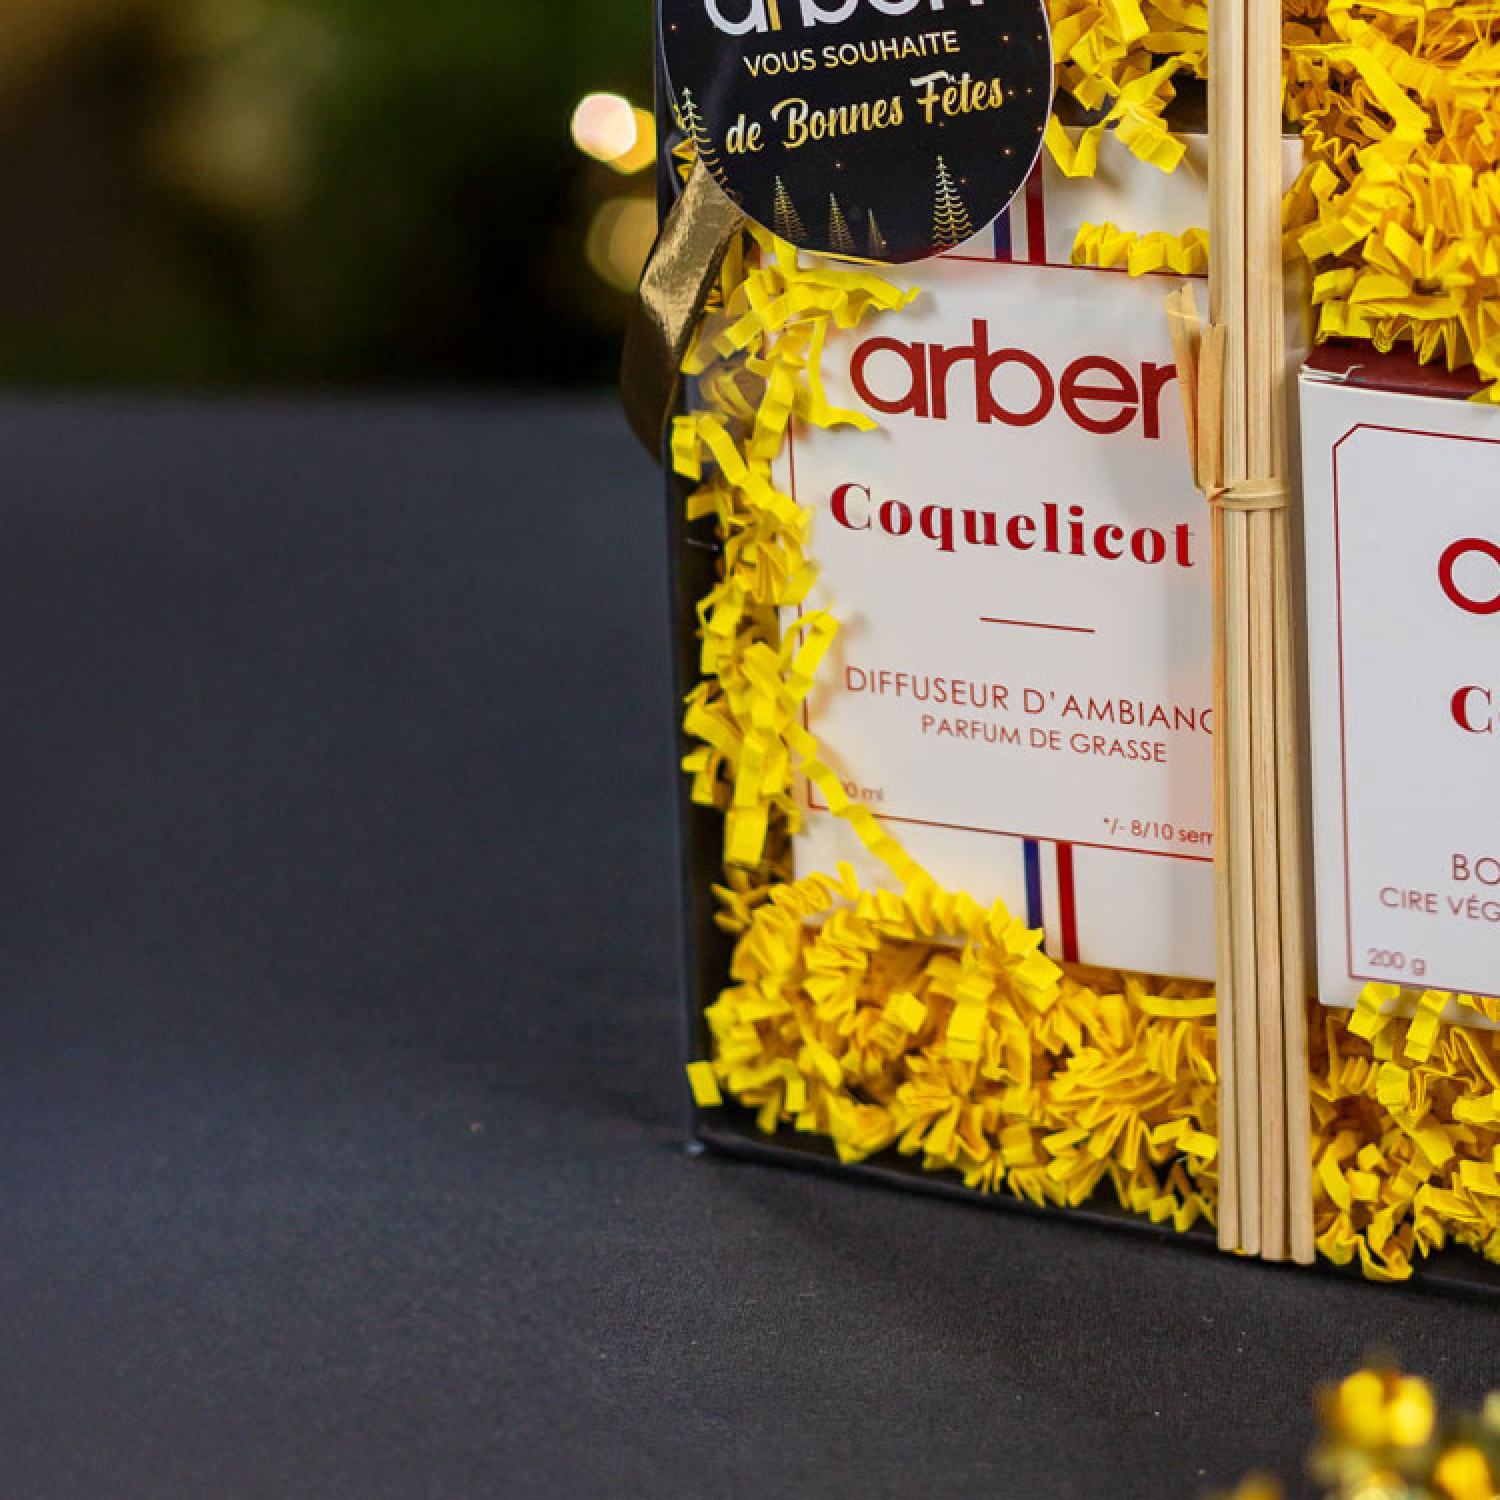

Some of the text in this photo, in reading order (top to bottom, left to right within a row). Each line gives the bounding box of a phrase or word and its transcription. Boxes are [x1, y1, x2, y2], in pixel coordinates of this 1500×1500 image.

[742, 29, 961, 78] VOUS SOUHAITE
[725, 69, 1004, 155] de Bonnes Fêtes
[849, 317, 1177, 439] arber
[829, 482, 1196, 567] Coquelicot
[845, 665, 1213, 735] DIFFUSEUR D'AMBIANC
[920, 713, 1168, 763] PARFUM DE GRASSE
[1378, 885, 1439, 914] CIRE
[1367, 946, 1427, 977] 200 g
